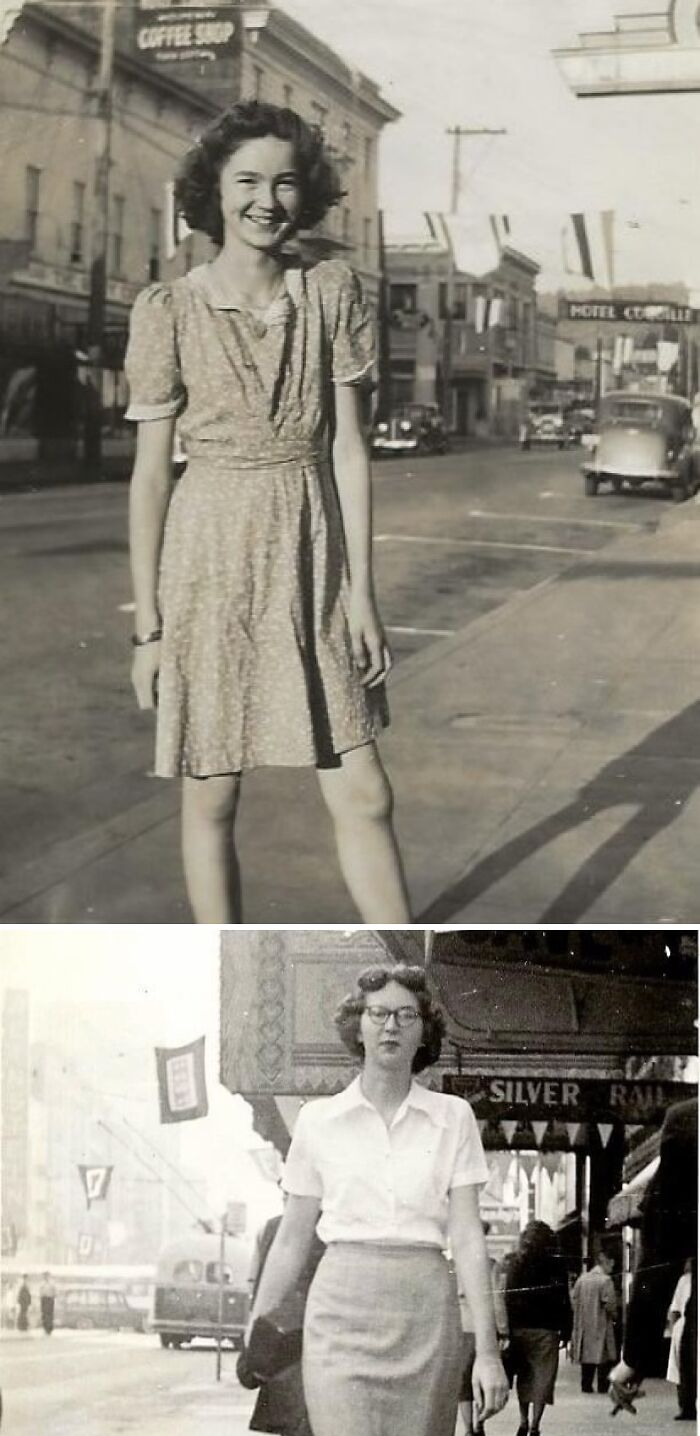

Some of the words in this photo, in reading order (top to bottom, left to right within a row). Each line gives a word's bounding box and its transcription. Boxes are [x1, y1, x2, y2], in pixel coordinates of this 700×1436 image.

[137, 25, 192, 49] COFFEE
[195, 21, 234, 45] SHOP
[623, 305, 692, 322] COILLE
[489, 1080, 581, 1106] SILVER
